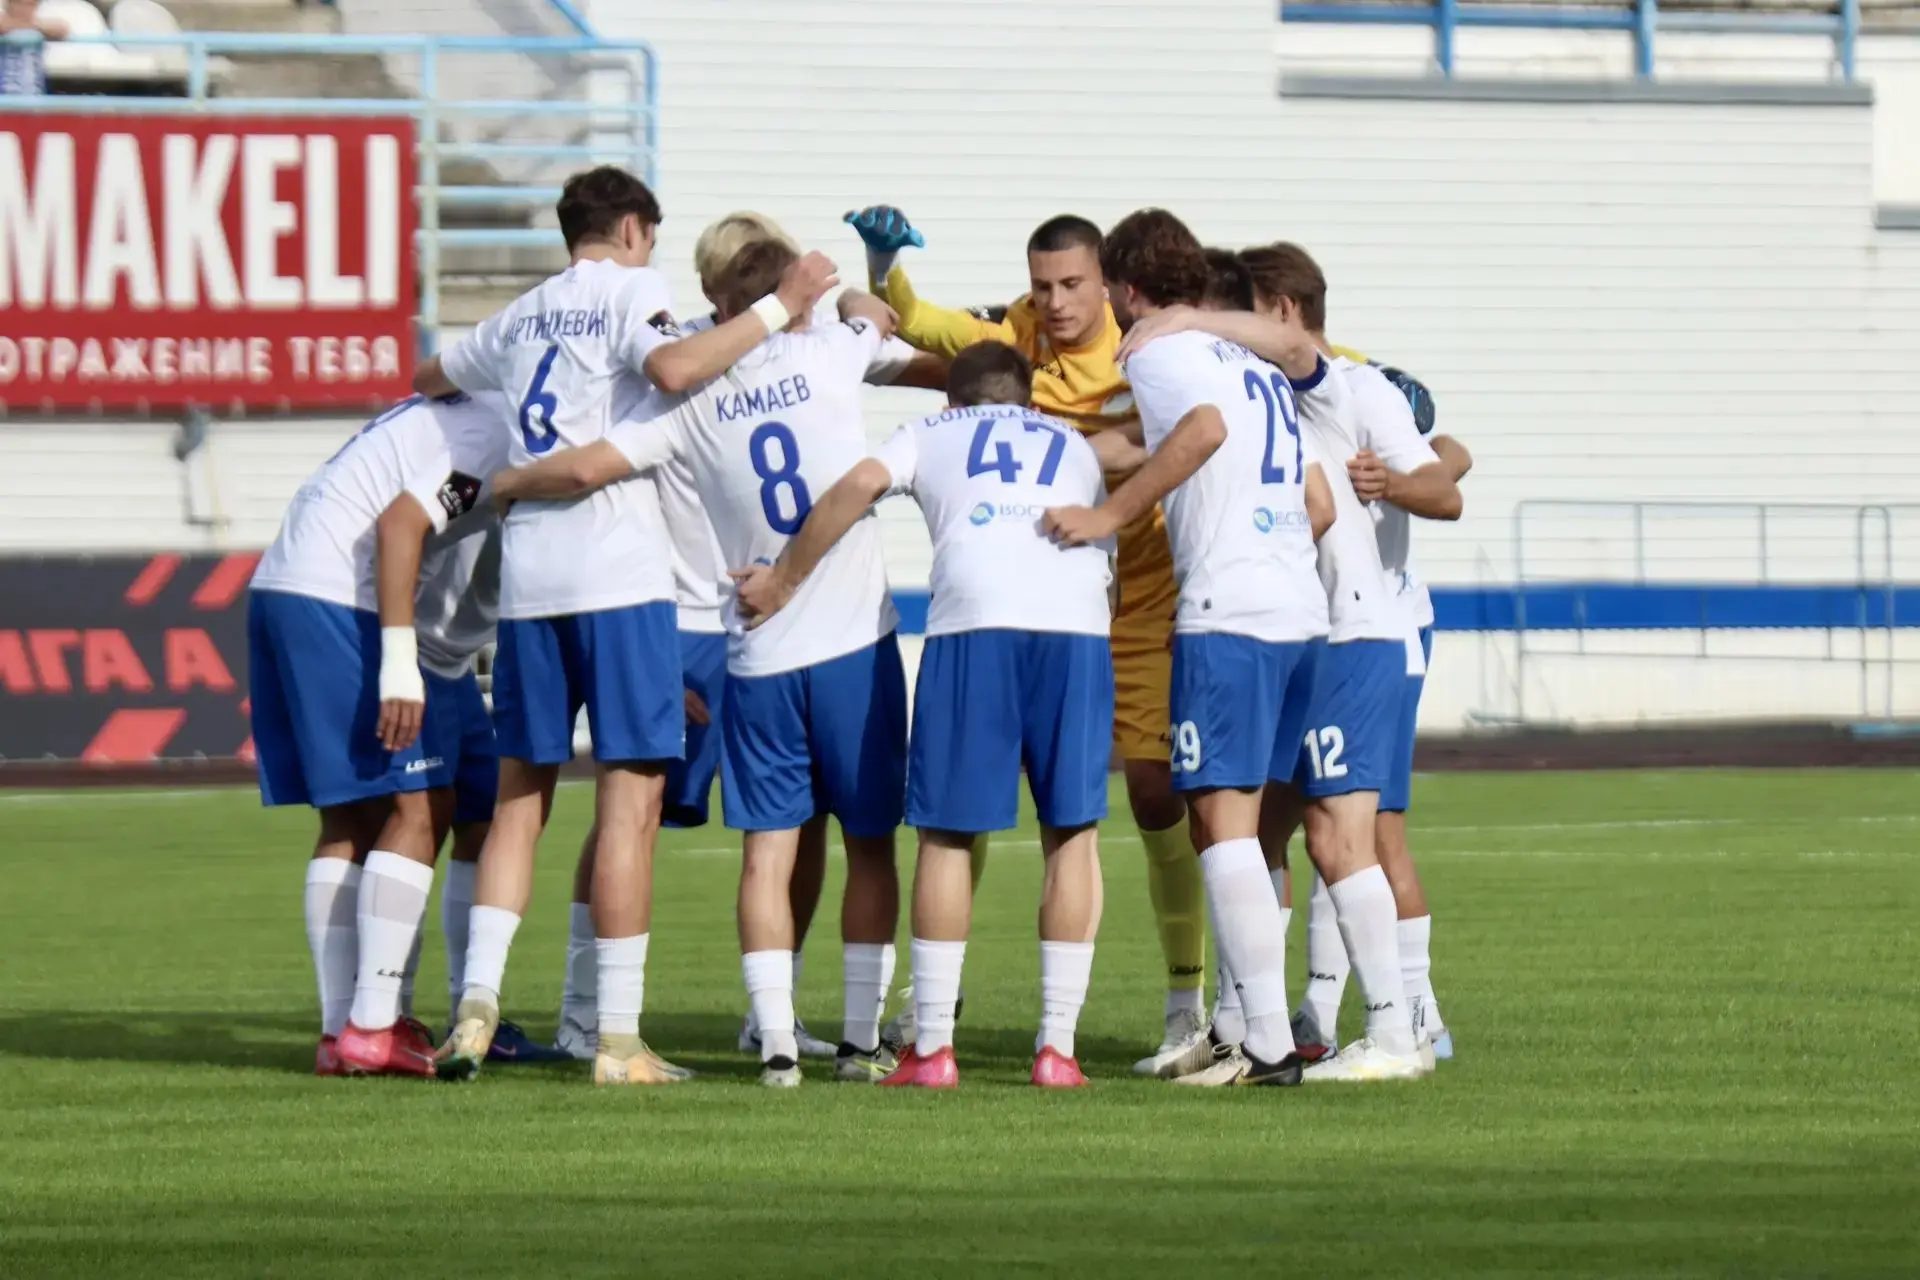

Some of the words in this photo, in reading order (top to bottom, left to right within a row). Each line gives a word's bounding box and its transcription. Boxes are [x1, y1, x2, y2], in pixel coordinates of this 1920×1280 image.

[0, 336, 272, 384] ОТРАЖЕНИЕ
[288, 335, 399, 384] ТЕБЯ
[519, 344, 558, 455] 6
[716, 373, 811, 423] КАМАЕВ
[1244, 368, 1303, 485] 29
[749, 421, 812, 536] 8
[966, 418, 1067, 487] 47
[164, 627, 238, 693] А
[1170, 720, 1201, 773] 29
[1304, 725, 1348, 780] 12
